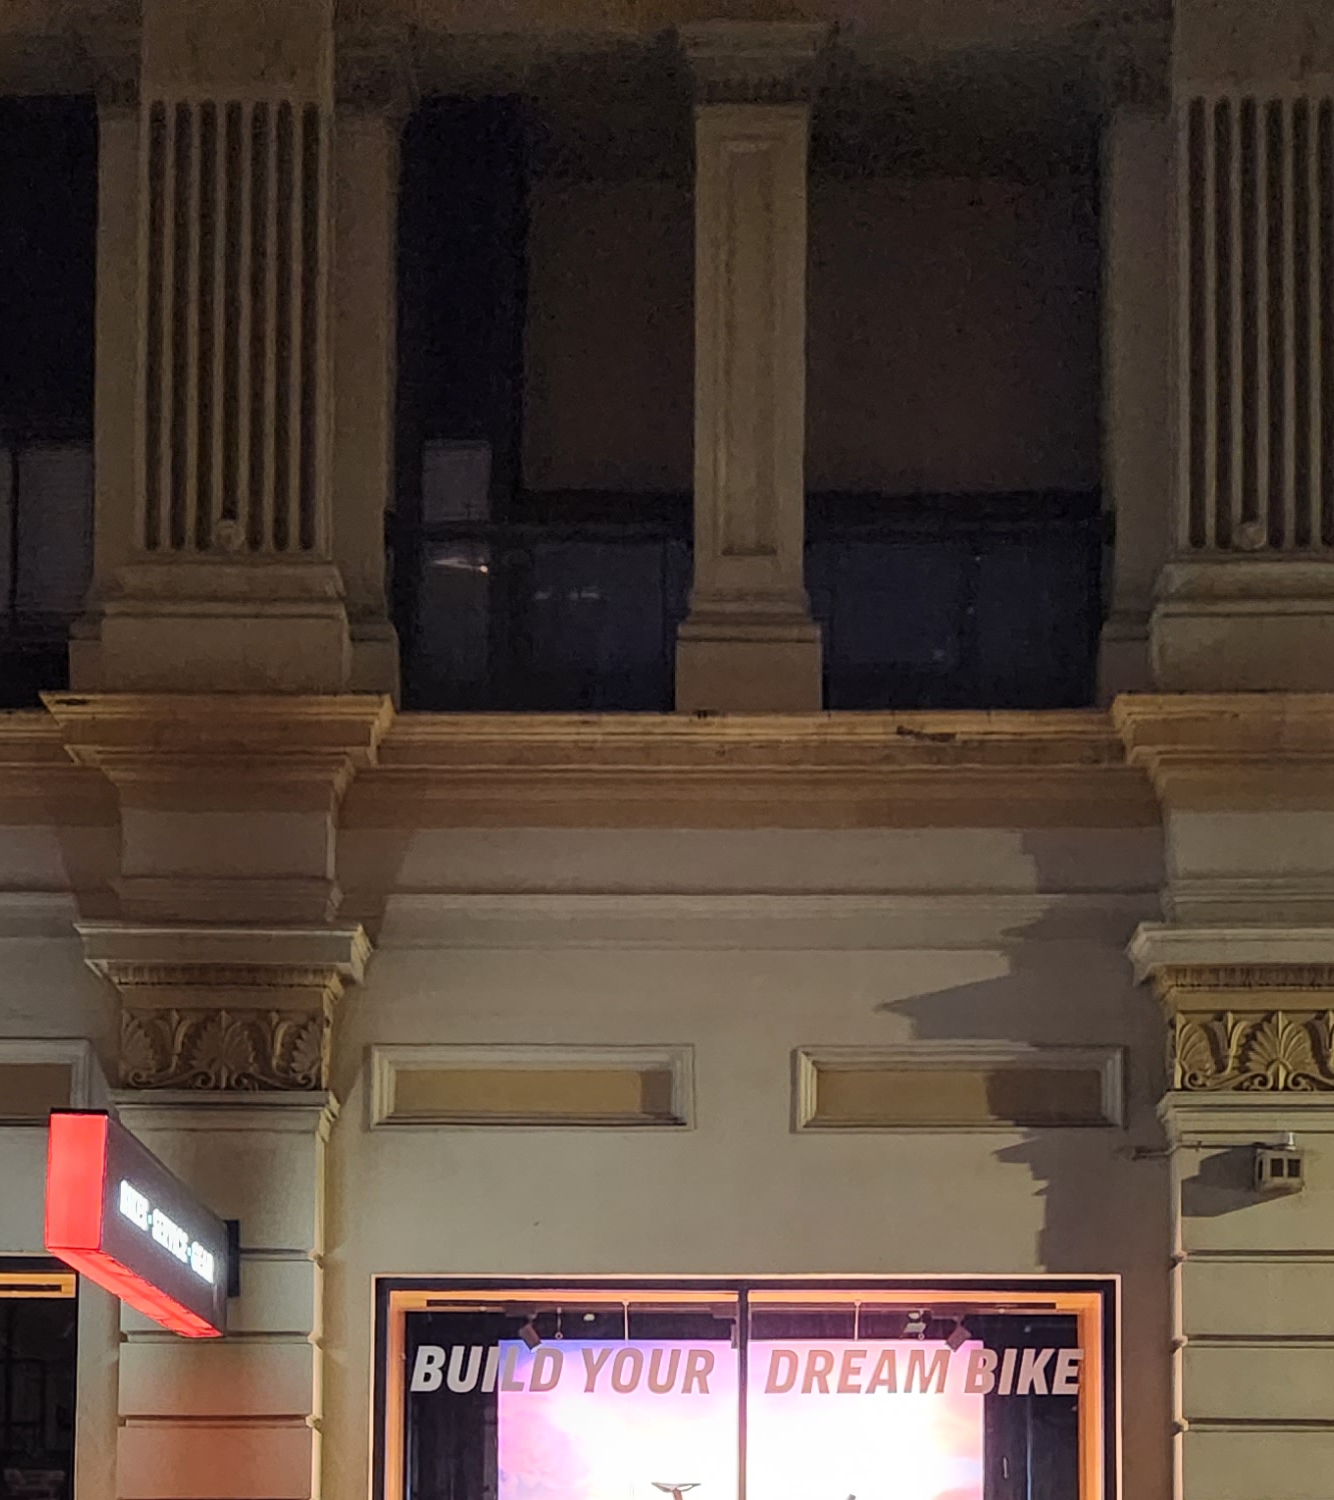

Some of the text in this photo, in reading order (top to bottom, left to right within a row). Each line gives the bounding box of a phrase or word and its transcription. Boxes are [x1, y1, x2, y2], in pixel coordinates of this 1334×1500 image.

[410, 1345, 1084, 1396] BUILD YOUR DREAM BIKE
